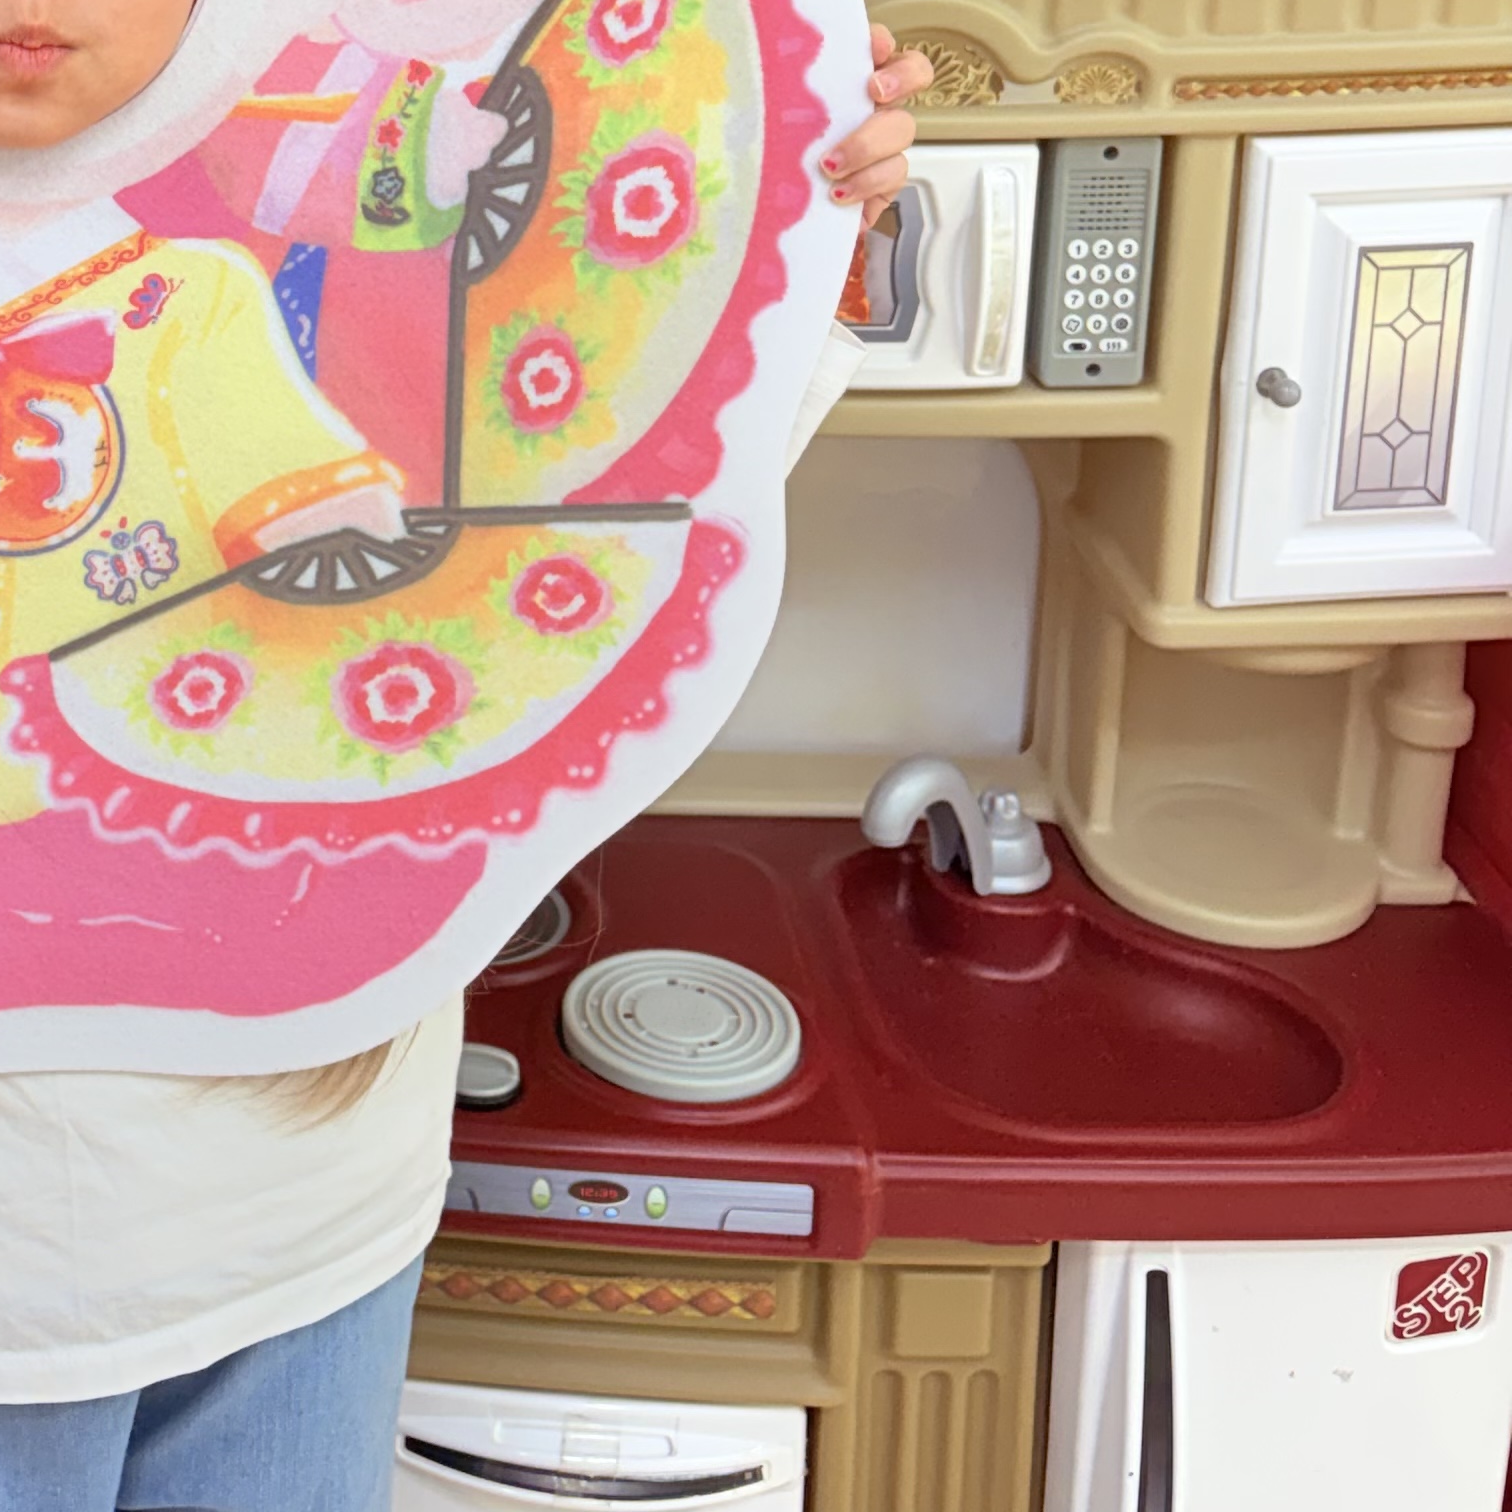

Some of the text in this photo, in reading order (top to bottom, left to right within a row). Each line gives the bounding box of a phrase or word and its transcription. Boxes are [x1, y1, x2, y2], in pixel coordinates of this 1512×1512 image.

[1098, 244, 1108, 256] 2
[1123, 243, 1133, 255] 3
[1071, 268, 1131, 280] 4 5 6
[1071, 293, 1128, 305] 7 8 9
[1093, 319, 1102, 331] 0
[1393, 1253, 1482, 1338] STEP
[1445, 1295, 1484, 1331] 2
